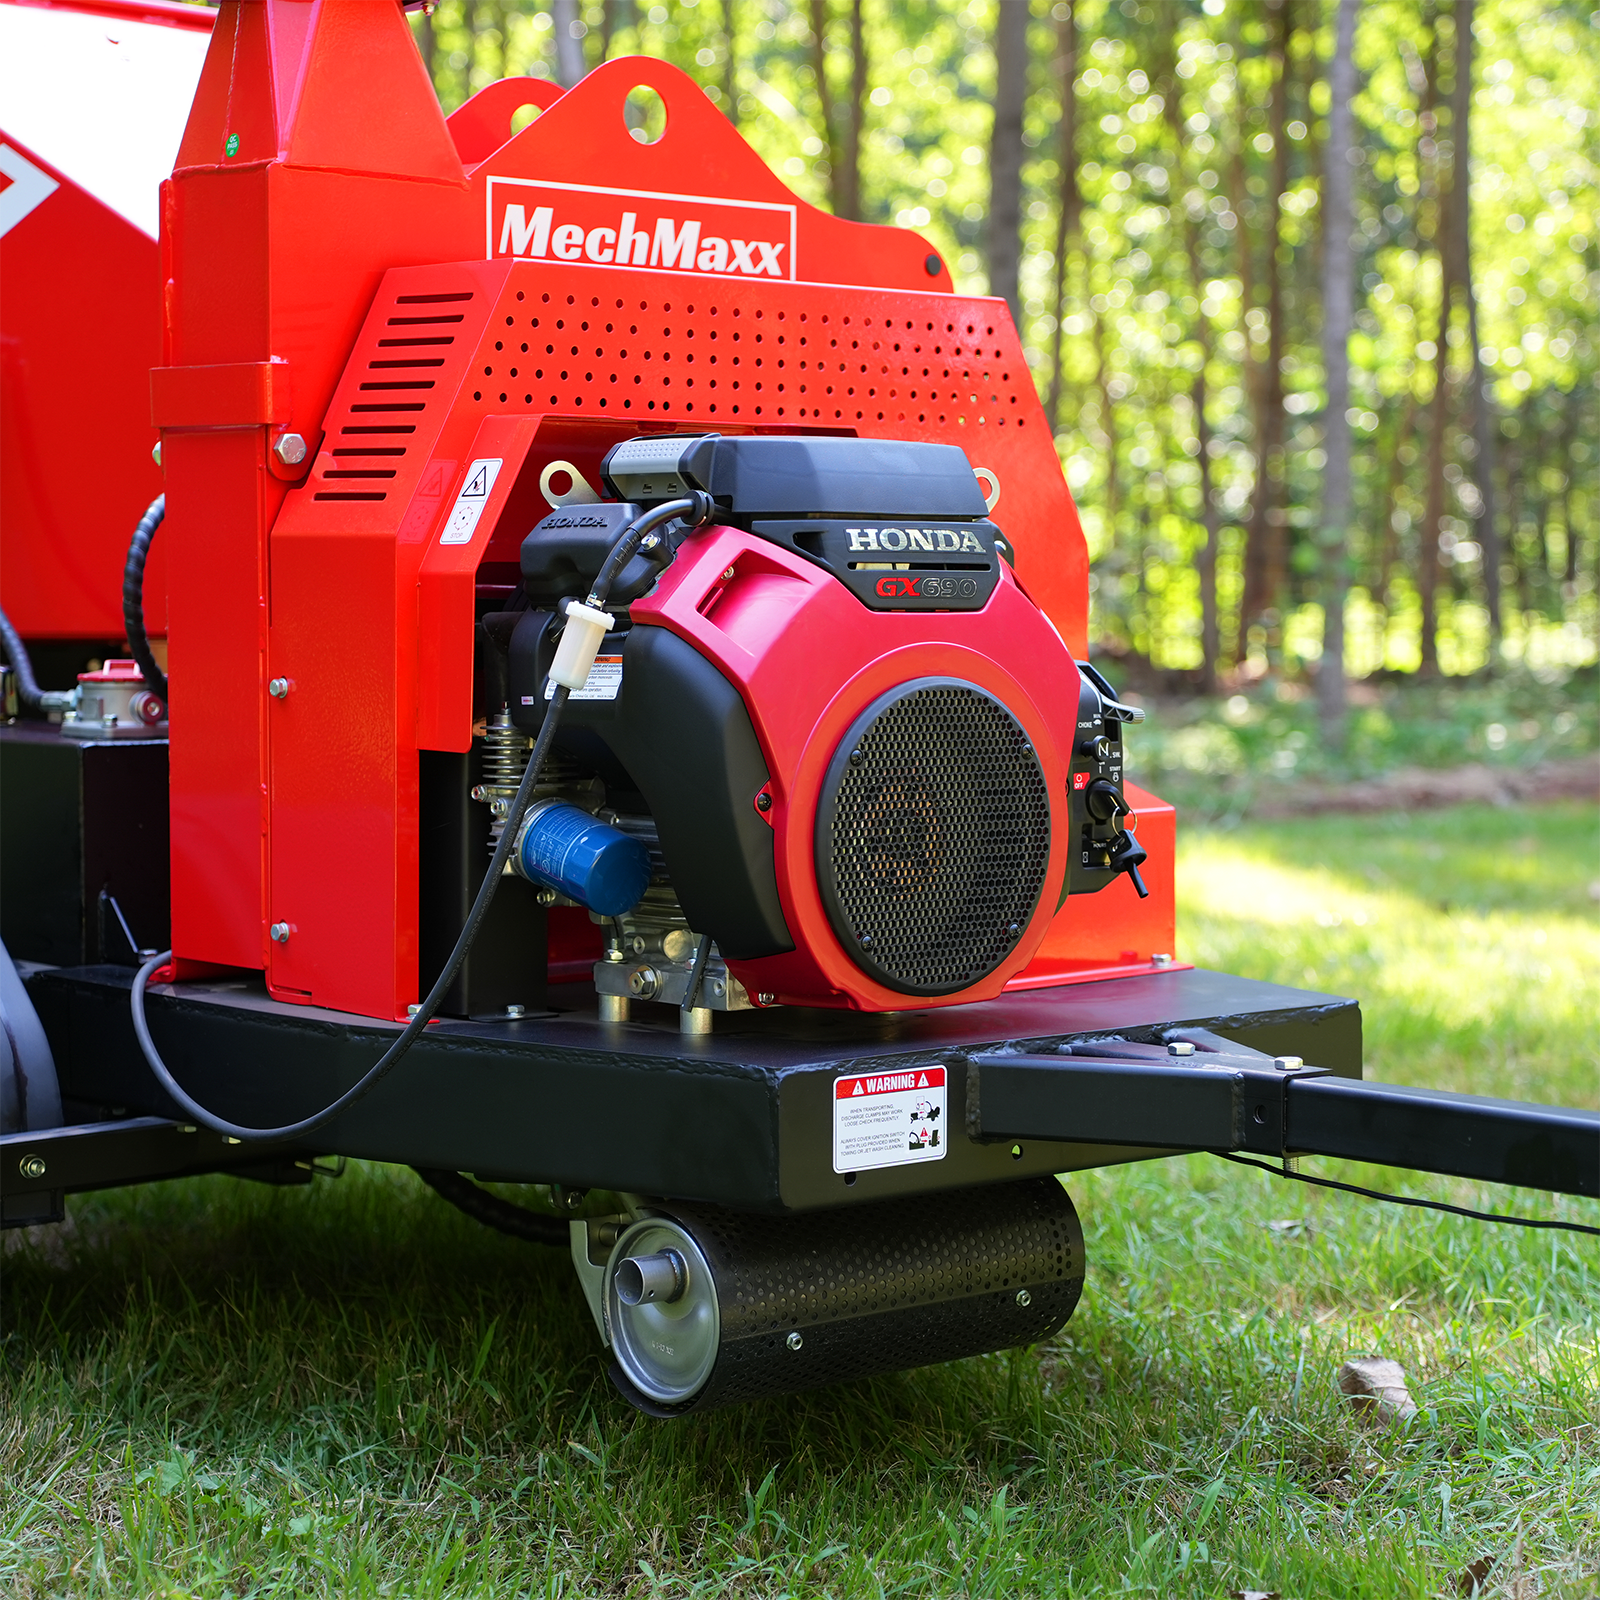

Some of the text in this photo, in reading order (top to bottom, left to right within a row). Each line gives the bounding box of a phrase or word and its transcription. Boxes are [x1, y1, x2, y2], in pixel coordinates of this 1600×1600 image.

[498, 204, 786, 276] MechMaxx
[541, 516, 610, 530] HONDA
[845, 528, 986, 552] HONDA
[876, 577, 977, 597] GX690
[866, 1074, 914, 1092] WARNING
